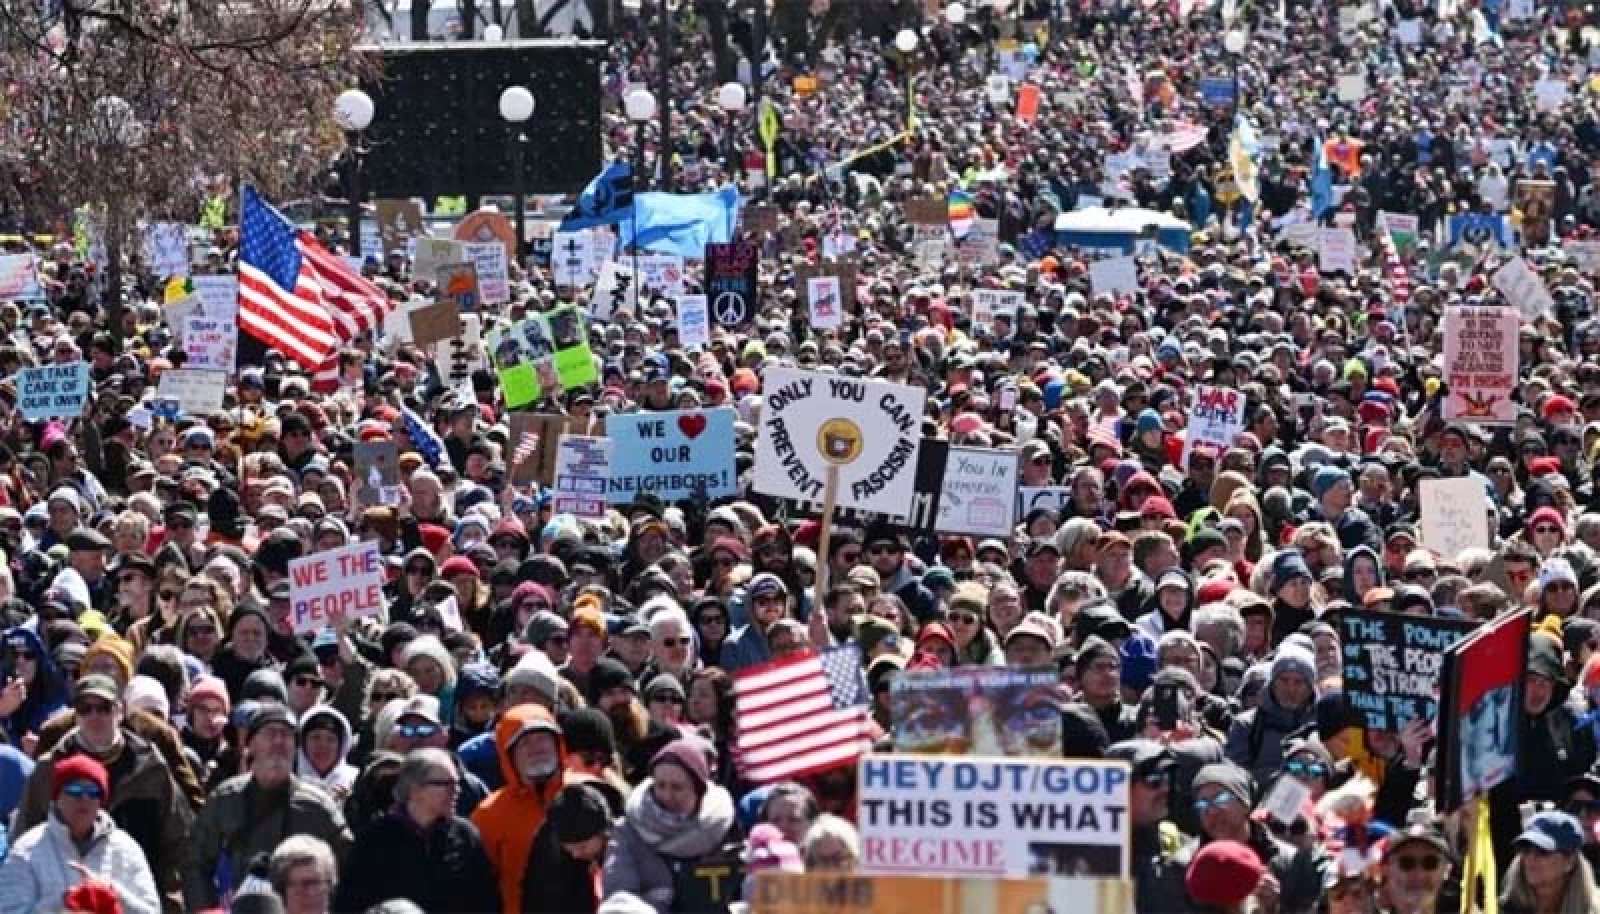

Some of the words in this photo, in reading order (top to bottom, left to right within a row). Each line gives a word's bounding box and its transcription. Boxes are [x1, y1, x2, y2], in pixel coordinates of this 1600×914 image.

[24, 368, 43, 382] WE
[48, 366, 78, 379] TAKE
[24, 381, 57, 394] CARE
[62, 380, 80, 392] OF
[22, 396, 50, 408] OUR
[54, 395, 81, 406] OWN
[768, 378, 813, 411] ONLY
[828, 378, 865, 402] YOU
[879, 393, 915, 431] CAN
[1198, 387, 1237, 414] WAR
[637, 420, 665, 439] WE
[650, 445, 691, 463] OUR
[766, 417, 824, 499] PREVENT
[852, 438, 915, 501] FASCISM
[292, 560, 328, 588] WE
[336, 549, 378, 577] THE
[295, 584, 380, 625] PEOPLE
[1344, 617, 1386, 641] THE
[864, 761, 945, 790] HEY
[953, 763, 1126, 794] DJT/GOP
[863, 799, 952, 828] THIS
[964, 801, 999, 829] IS
[1011, 803, 1127, 833] WHAT
[864, 836, 1005, 866] REGIME
[758, 877, 874, 906] DUMB
